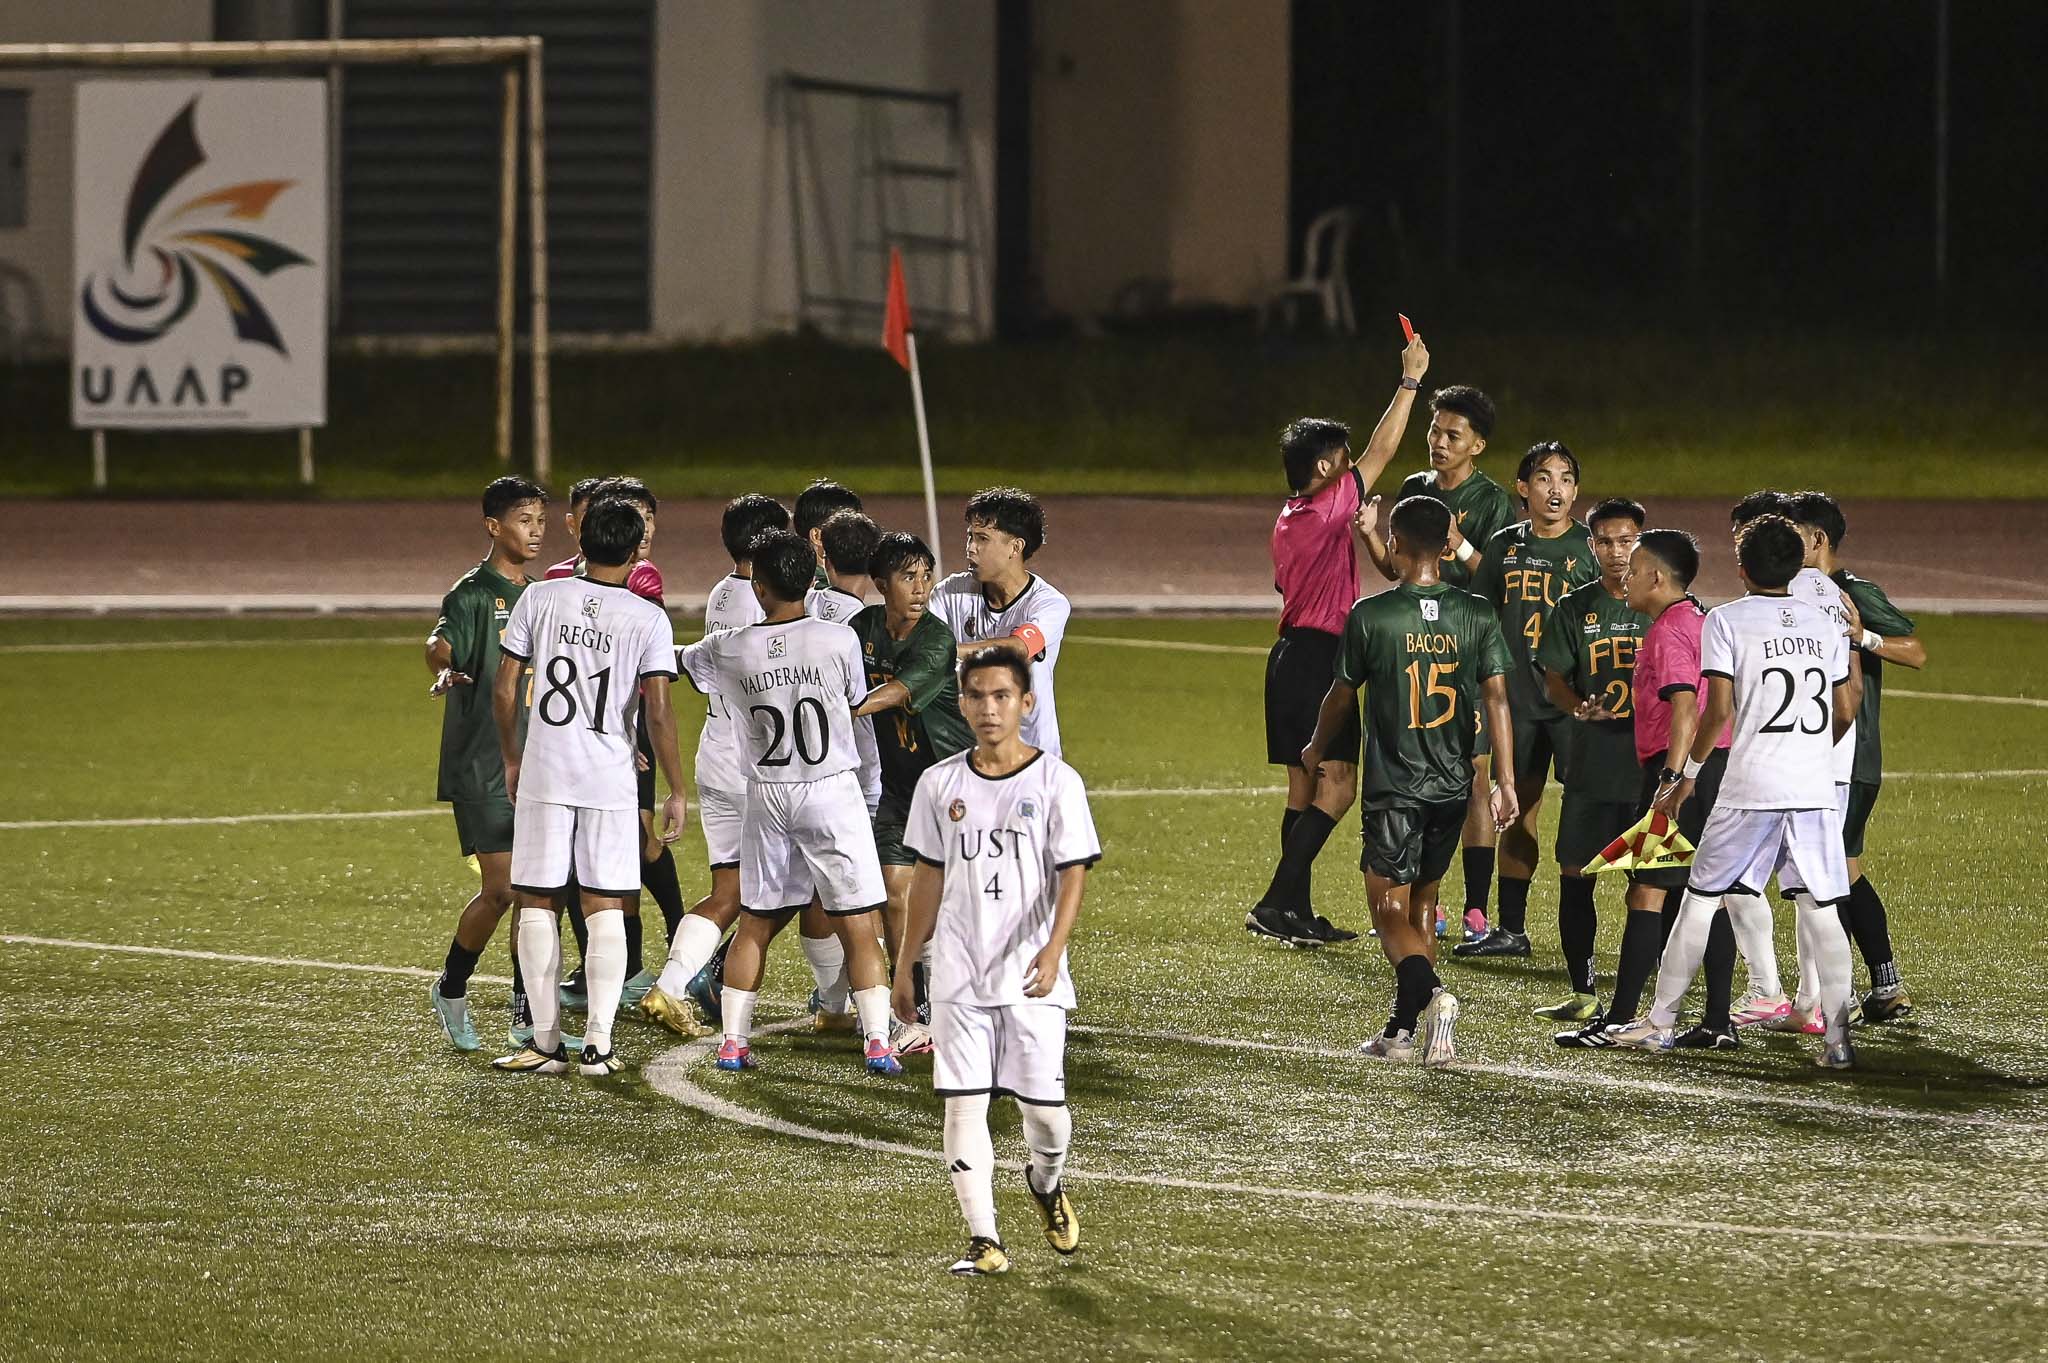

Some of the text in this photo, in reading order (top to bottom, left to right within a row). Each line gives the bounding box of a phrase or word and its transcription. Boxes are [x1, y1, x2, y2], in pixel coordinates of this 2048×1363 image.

[82, 364, 249, 405] UAAP
[1503, 569, 1570, 608] FEU
[558, 624, 613, 654] REGIS
[1023, 627, 1036, 639] C
[1406, 632, 1458, 654] BACON
[1523, 611, 1543, 649] 4
[1763, 637, 1823, 660] ELOPRE
[538, 655, 610, 735] 81
[739, 665, 824, 697] VALDERAMA
[1405, 658, 1460, 730] 15
[1759, 666, 1830, 736] 23
[749, 696, 830, 768] 20
[959, 828, 1028, 862] UST
[984, 871, 1003, 901] 4
